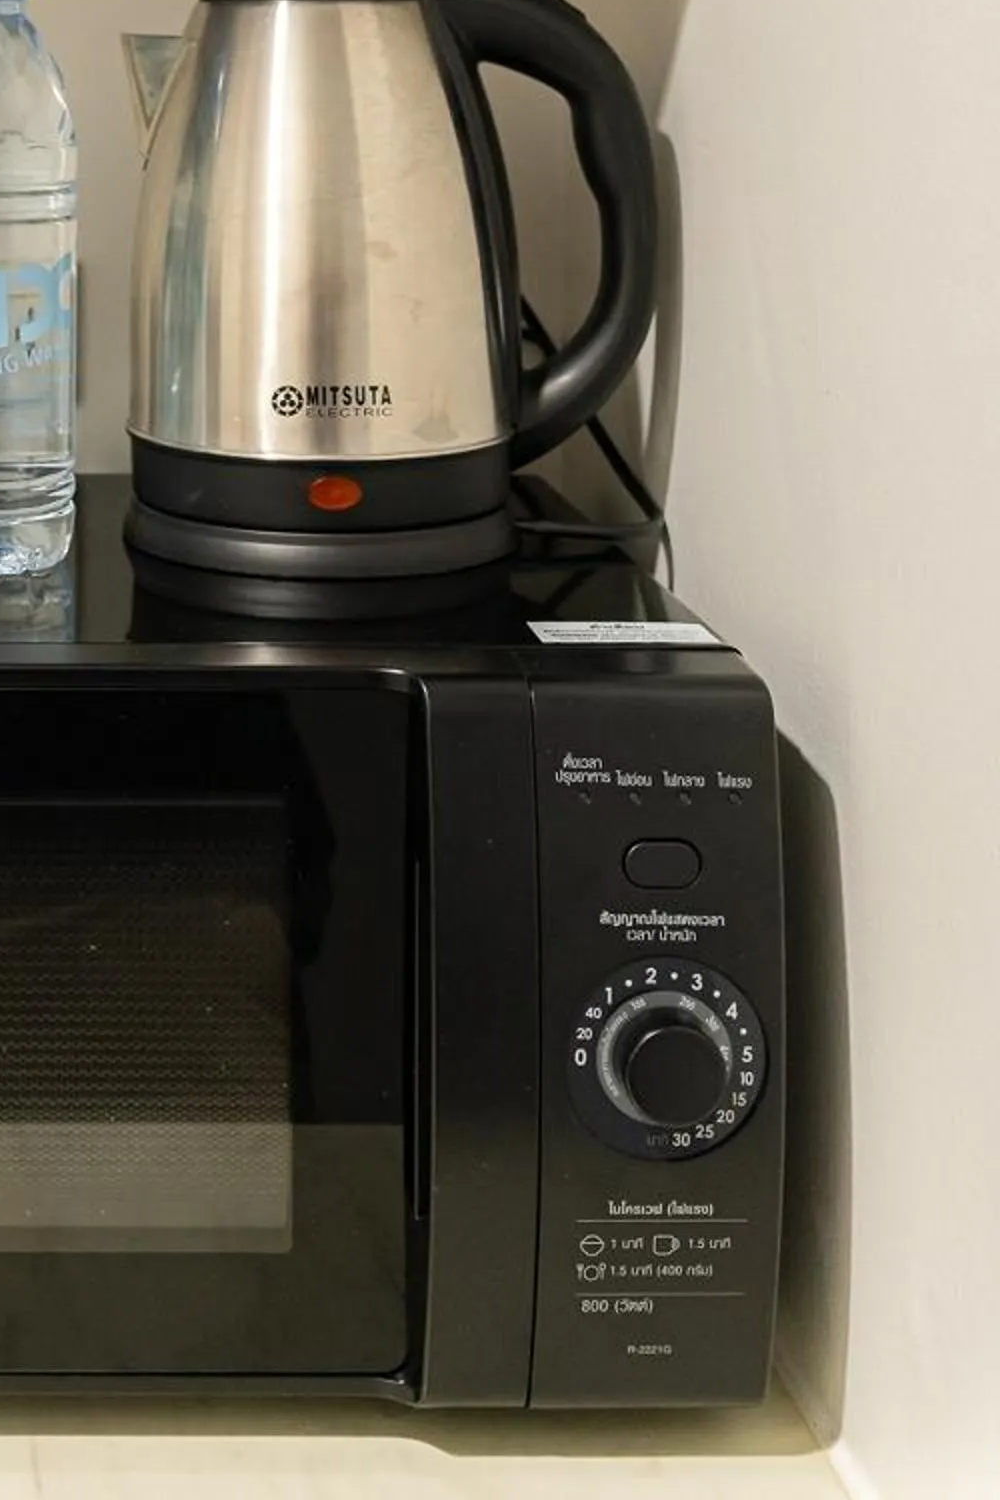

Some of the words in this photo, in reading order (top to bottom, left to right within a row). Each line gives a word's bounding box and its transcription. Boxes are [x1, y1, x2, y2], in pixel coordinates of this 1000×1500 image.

[305, 385, 393, 406] MITSUTA
[305, 407, 394, 419] ELECTRIC
[645, 967, 657, 985] 2
[692, 973, 703, 991] 3
[604, 987, 613, 1005] 1
[585, 1007, 602, 1019] 40
[725, 1002, 738, 1020] 4
[576, 1027, 593, 1041] 20
[574, 1048, 587, 1067] 0
[742, 1046, 753, 1063] 5
[740, 1071, 754, 1086] 10
[732, 1091, 747, 1107] 15
[716, 1109, 735, 1124] 20
[671, 1132, 691, 1147] 30
[695, 1124, 715, 1140] 25
[611, 1238, 617, 1249] 1
[581, 1299, 609, 1313] 800
